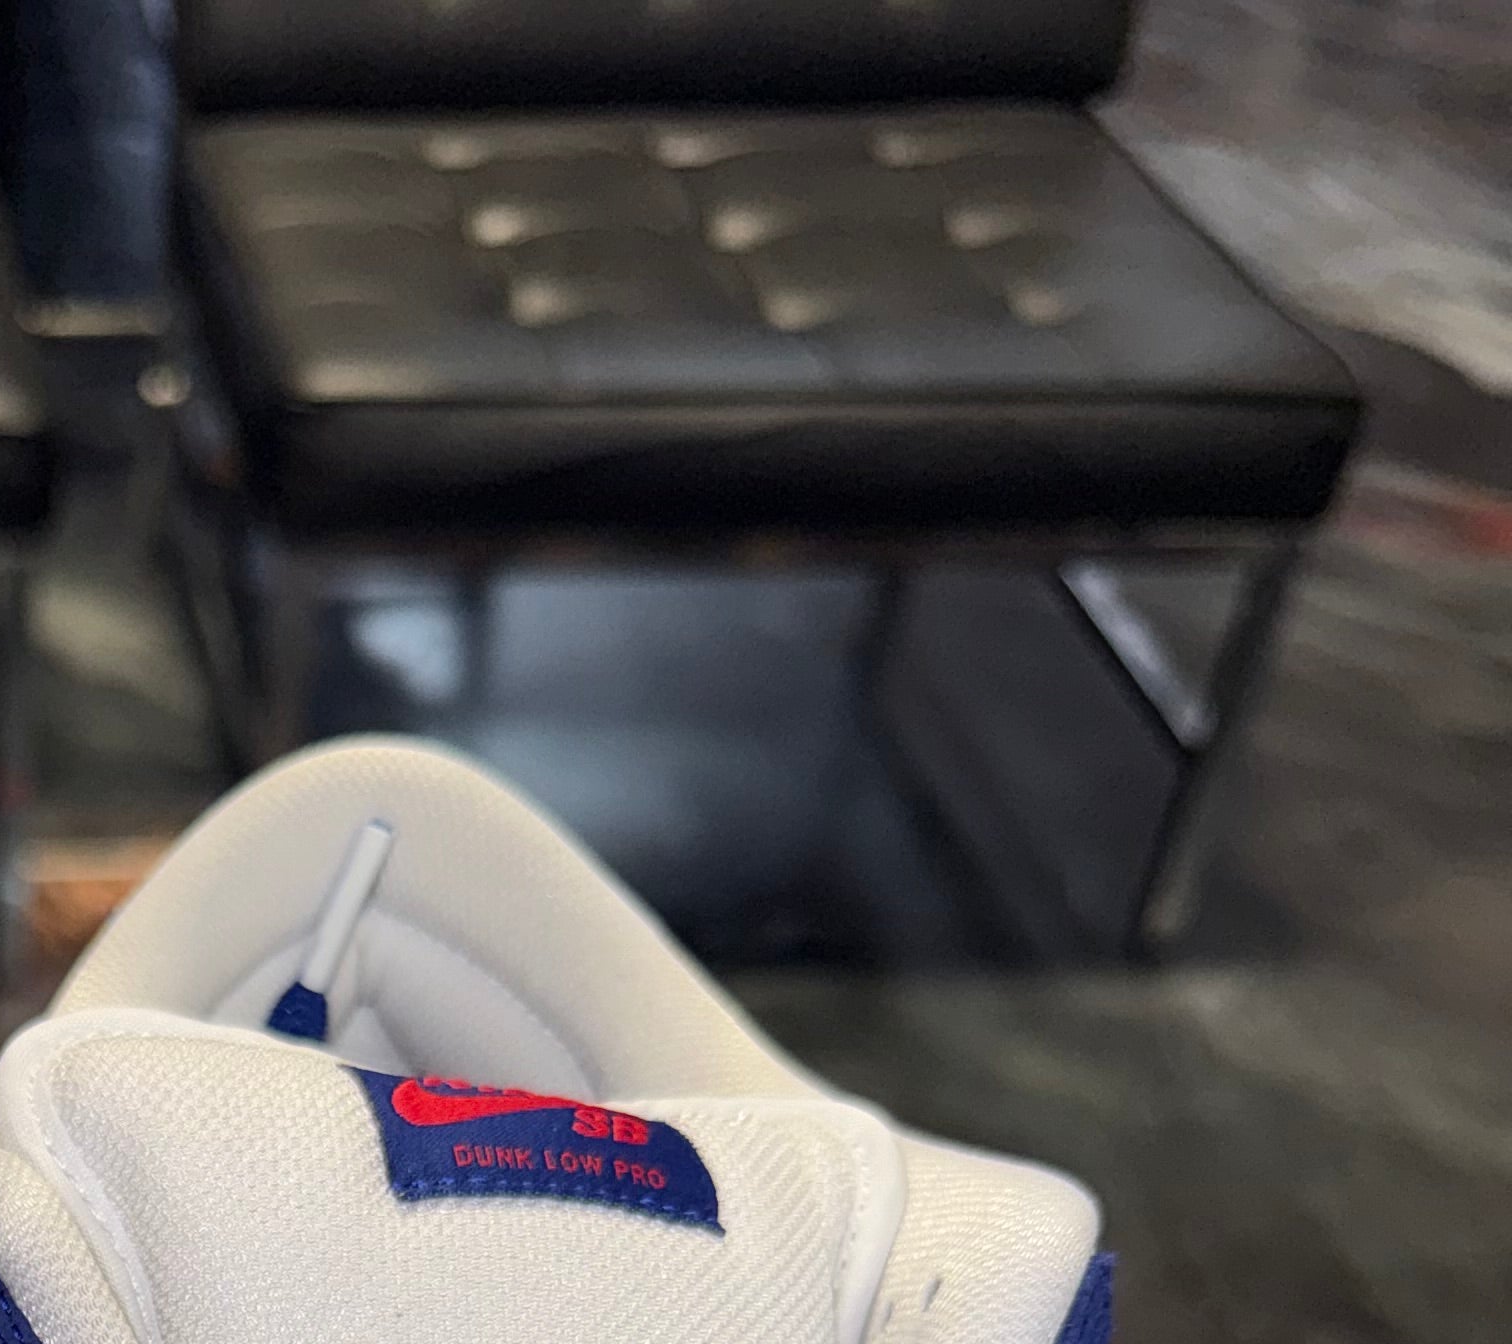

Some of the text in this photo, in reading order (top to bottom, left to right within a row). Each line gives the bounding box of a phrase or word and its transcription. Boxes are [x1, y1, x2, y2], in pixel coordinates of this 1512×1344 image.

[571, 1107, 649, 1146] SB
[453, 1144, 667, 1190] DUNK LOW PRO
